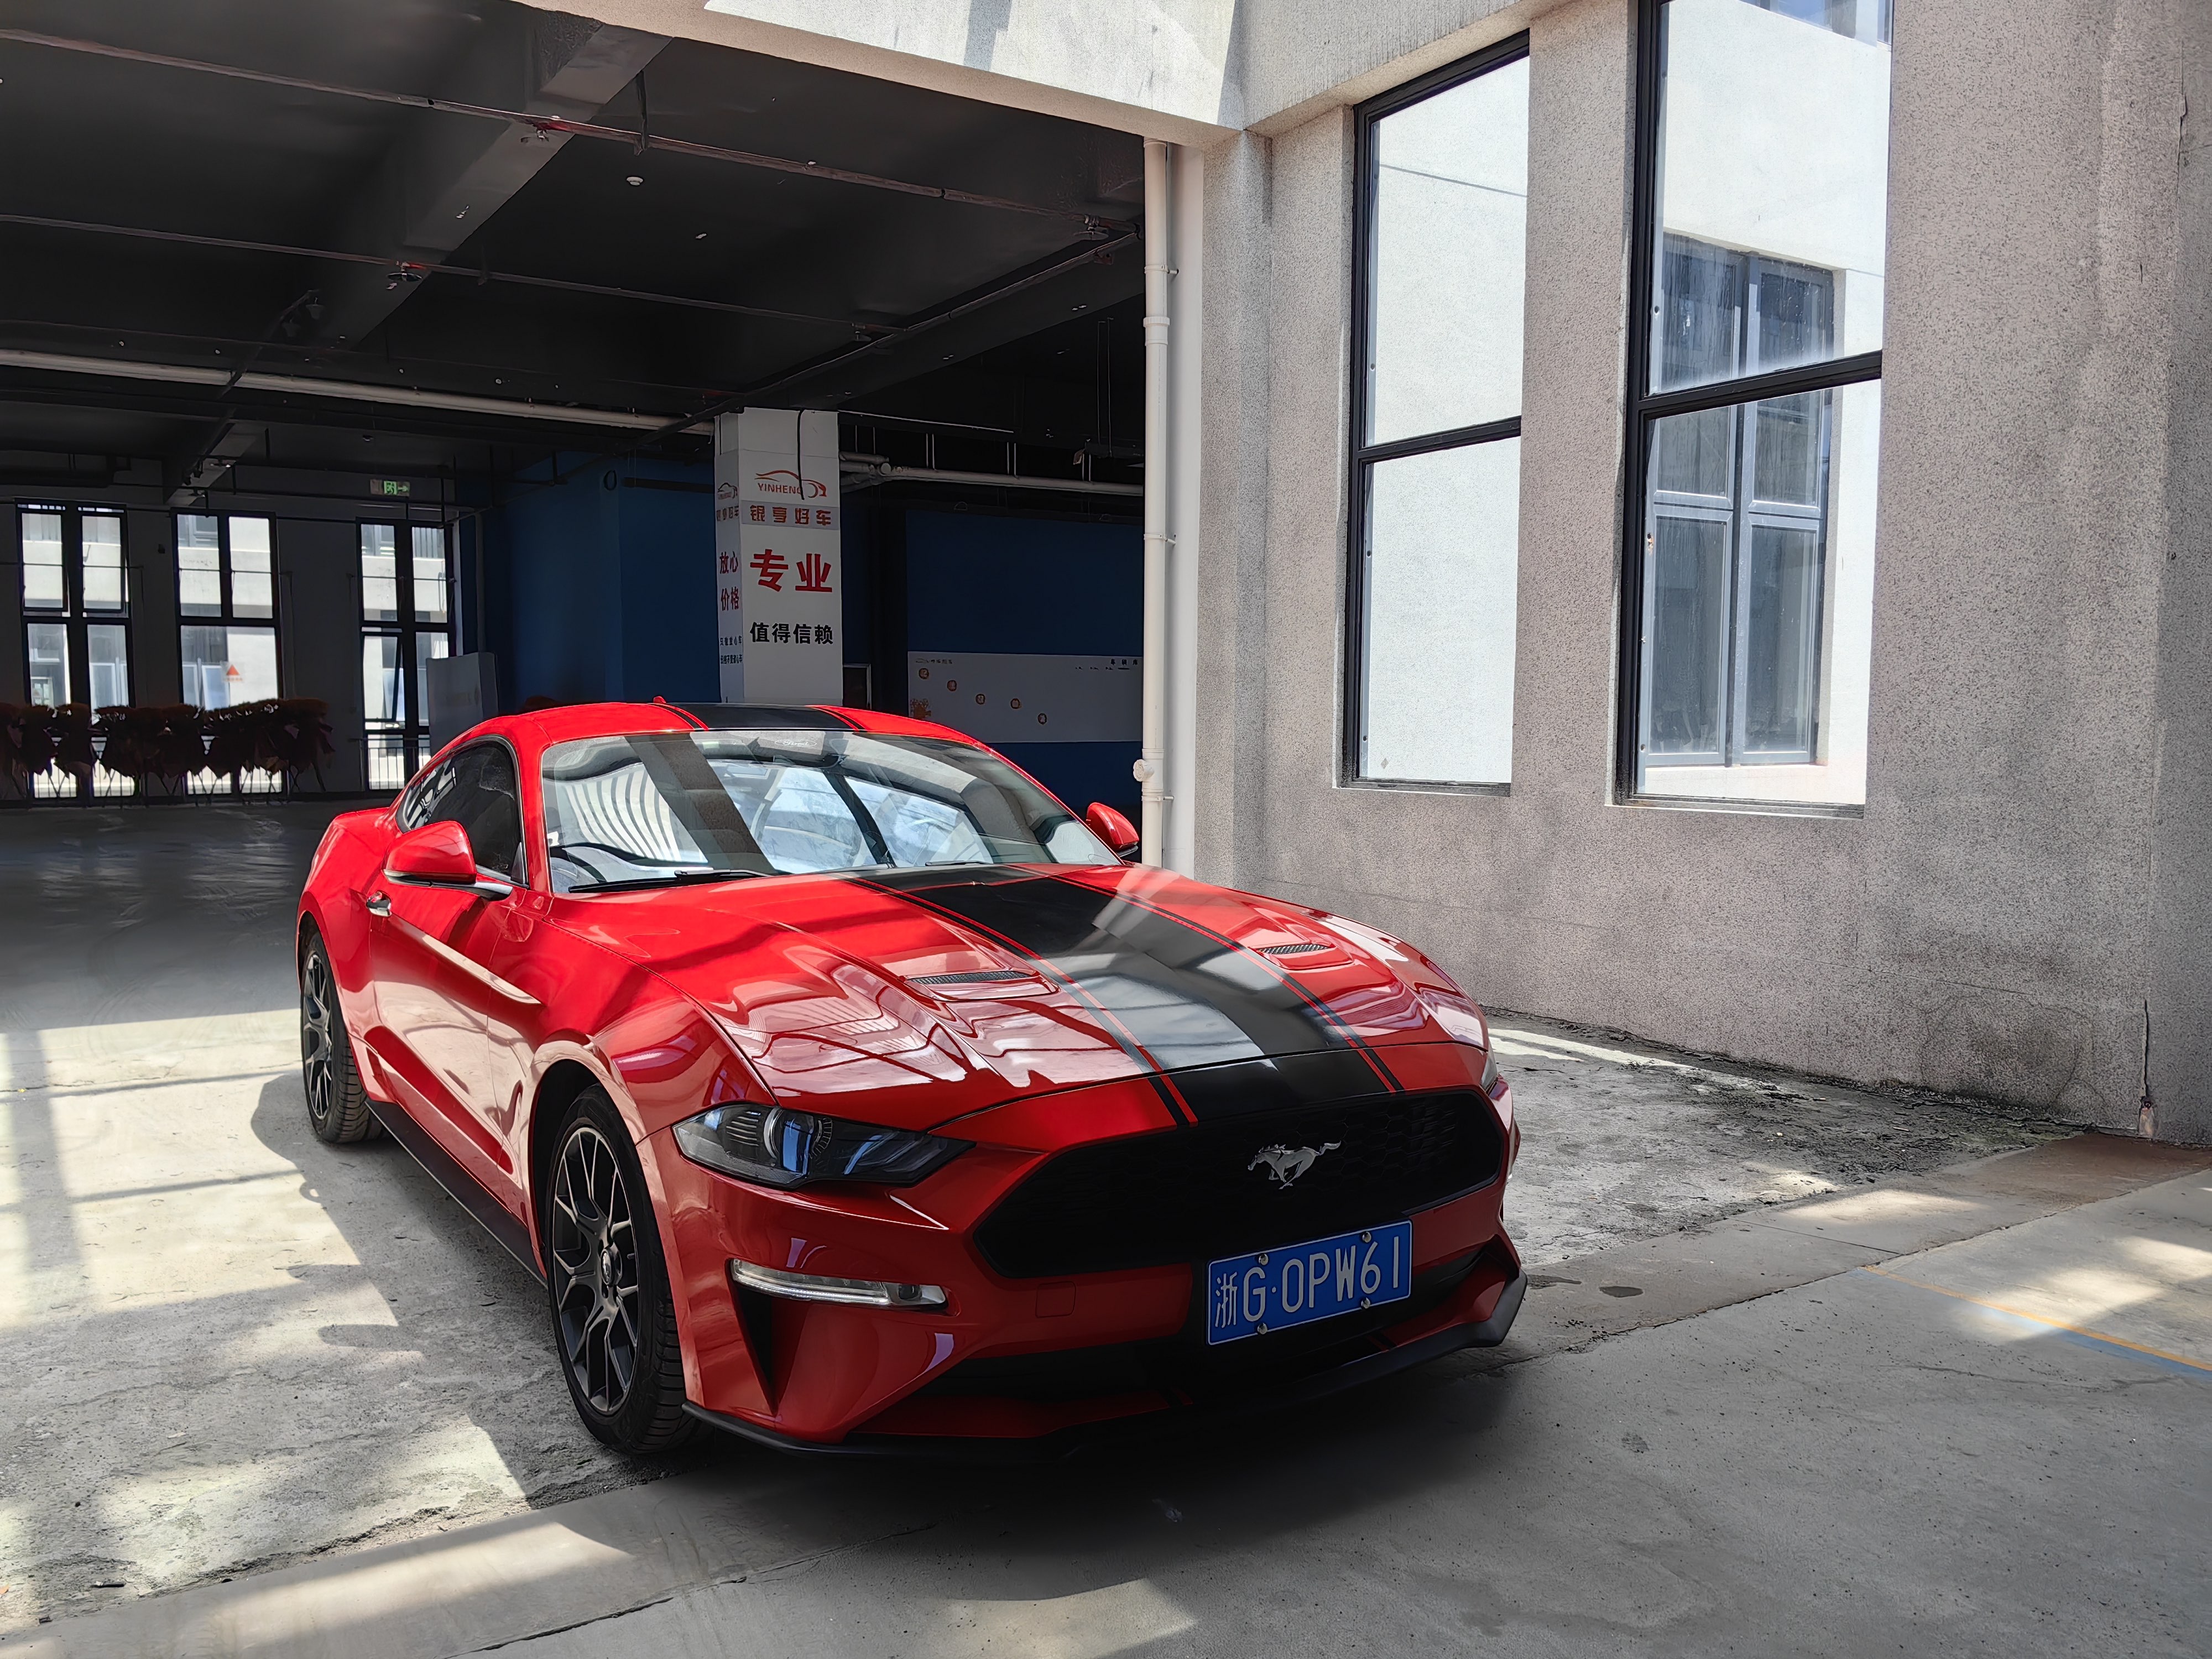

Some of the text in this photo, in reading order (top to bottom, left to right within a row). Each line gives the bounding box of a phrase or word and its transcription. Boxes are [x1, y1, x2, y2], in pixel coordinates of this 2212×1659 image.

[719, 551, 739, 574] 放心
[750, 549, 833, 592] 专业
[721, 586, 739, 611] 价格
[750, 622, 833, 645] 值得信赖
